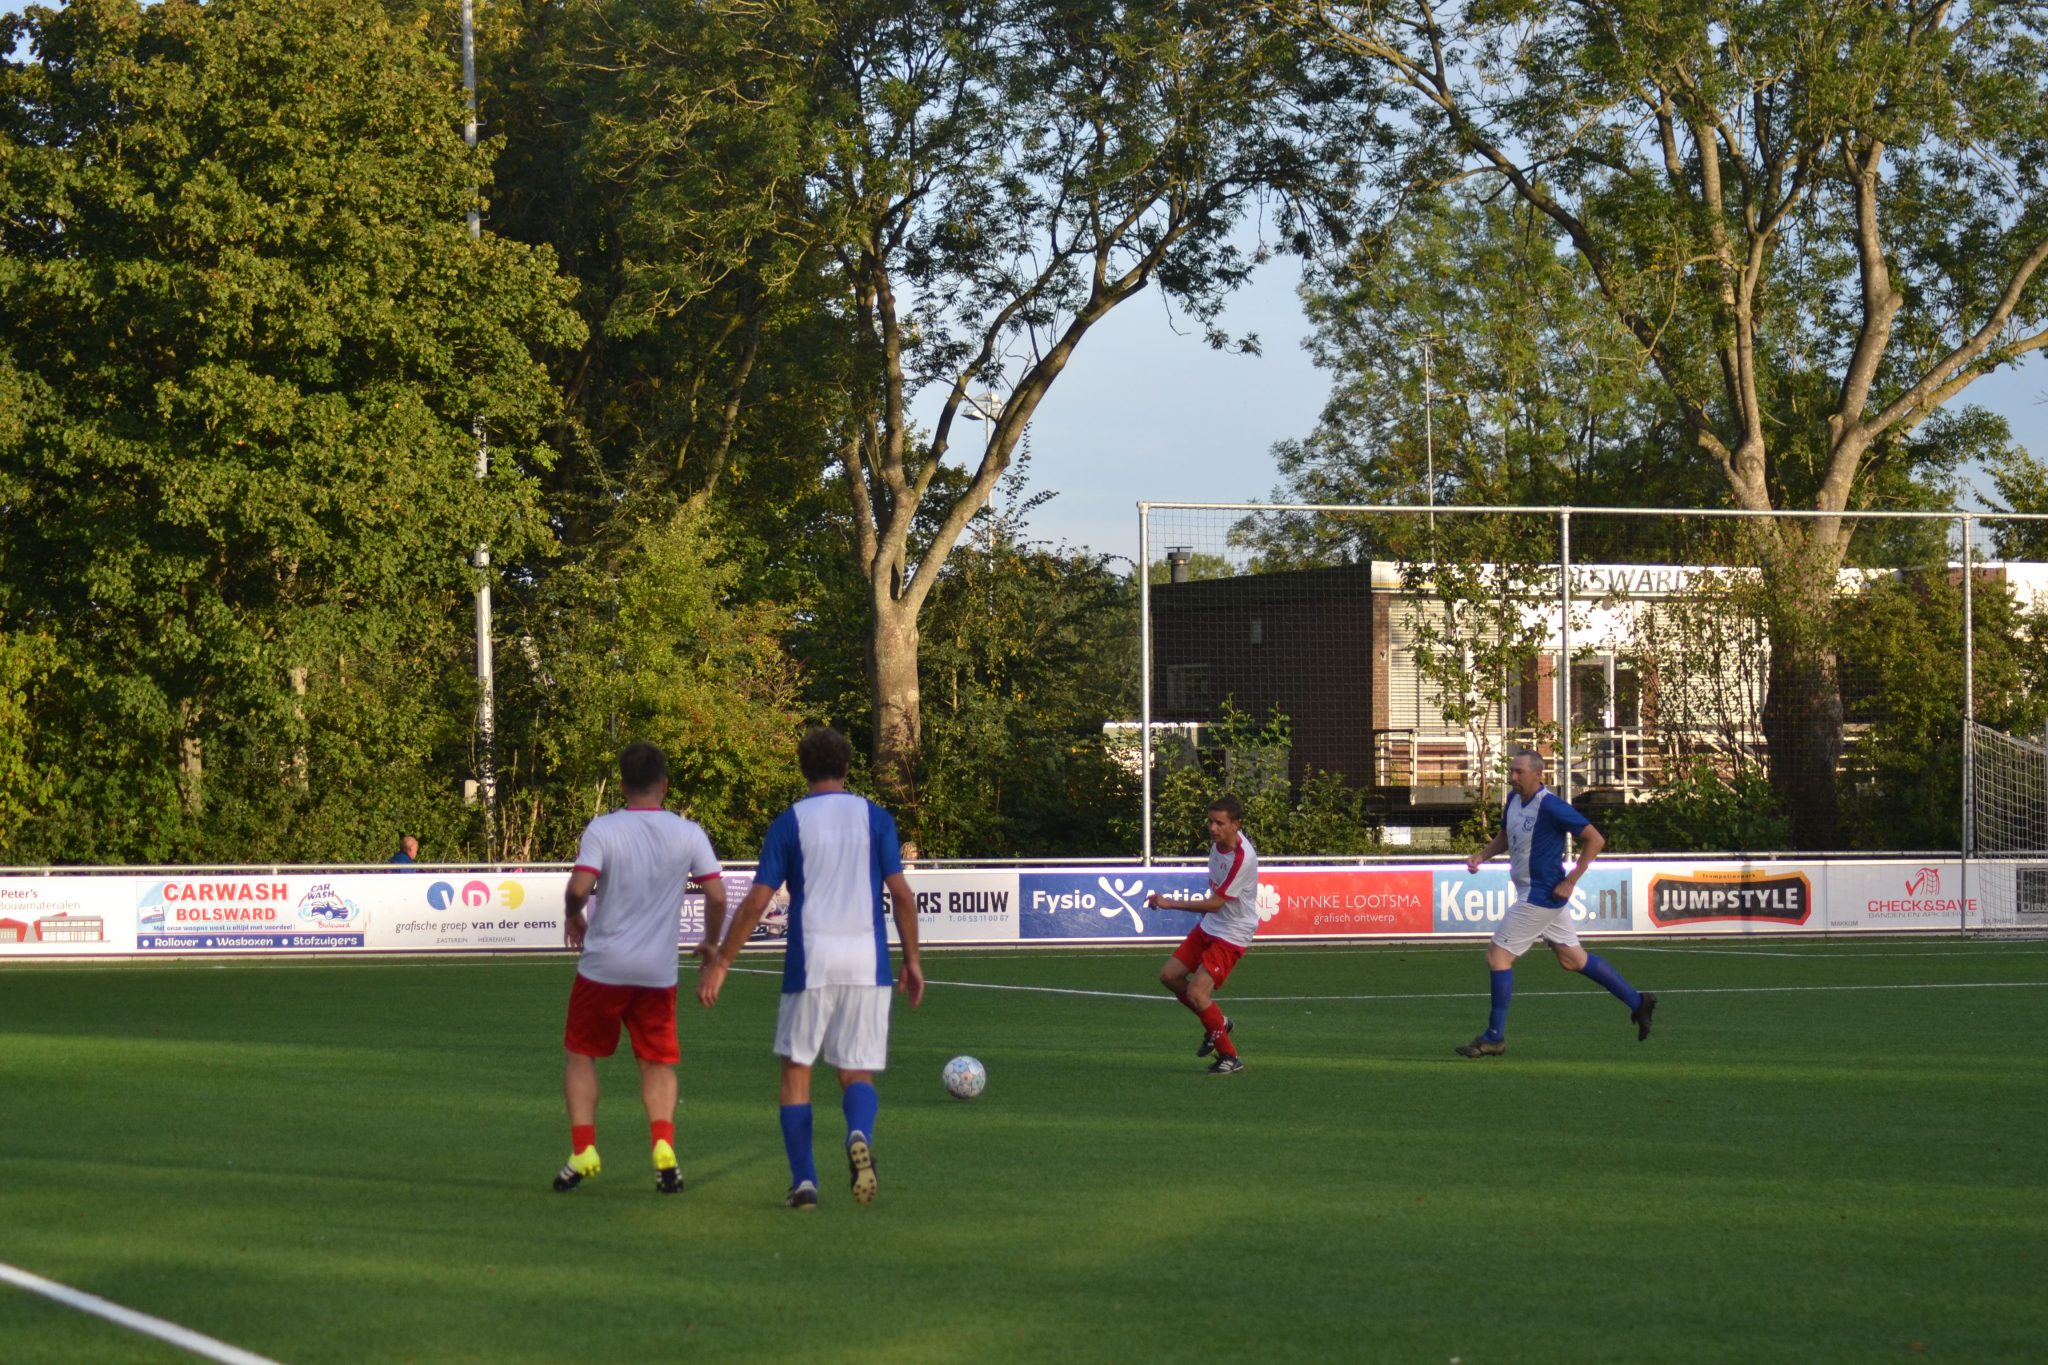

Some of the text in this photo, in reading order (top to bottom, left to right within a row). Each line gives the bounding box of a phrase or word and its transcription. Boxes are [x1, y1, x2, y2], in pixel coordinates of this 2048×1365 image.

[1, 889, 38, 899] Peter's
[163, 883, 288, 901] CARWASH
[307, 890, 335, 900] WASH
[310, 883, 331, 893] CAR
[949, 891, 1009, 913] BOUW
[1032, 889, 1096, 914] Fysio
[1287, 894, 1421, 909] NYNKE LOOTSMA
[1659, 887, 1799, 912] JUMPSTYLE
[1867, 899, 1977, 912] CHECK&SAVE
[176, 907, 277, 921] BOLSWARD
[1314, 913, 1395, 926] grafisch ontwerp
[395, 919, 557, 933] grafische groep van der eems
[154, 936, 358, 947] Rollover Wasboxen Stofzuigers
